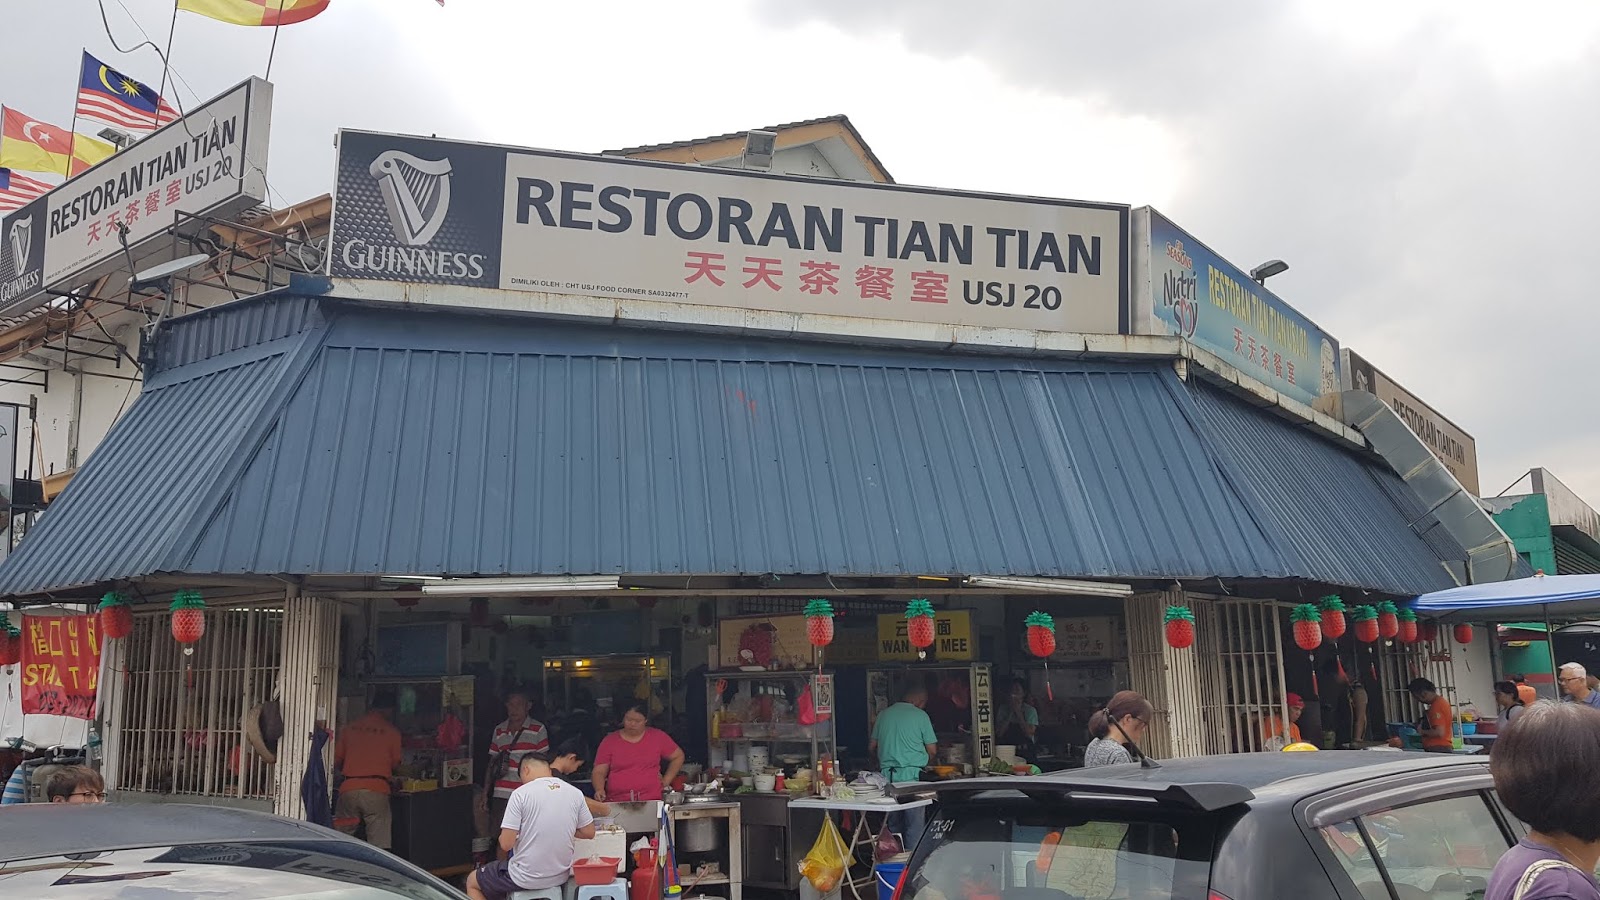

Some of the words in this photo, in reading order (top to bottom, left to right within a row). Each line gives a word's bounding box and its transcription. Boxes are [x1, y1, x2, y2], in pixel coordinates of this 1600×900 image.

[50, 162, 144, 239] RESTORAN
[147, 142, 188, 187] TIAN
[192, 116, 237, 163] TIAN
[185, 168, 211, 195] USJ
[213, 155, 233, 183] 20
[87, 178, 182, 246] 天天茶餐室
[516, 177, 843, 253] RESTORAN
[854, 215, 973, 265] TIAN
[986, 227, 1101, 276] TIAN
[342, 240, 484, 279] GUINNESS
[684, 251, 950, 304] 天天茶餐室
[0, 269, 39, 301] GUINNESS
[511, 277, 539, 286] DIMILIKI
[540, 280, 560, 288] OLEH
[596, 285, 616, 293] FOOD
[617, 287, 647, 296] CORNER
[963, 280, 1016, 308] USJ
[1023, 284, 1062, 311] 20
[1163, 269, 1197, 306] Nutri
[1208, 264, 1251, 325] RESTORAN
[1251, 293, 1269, 337] TIAN
[1234, 327, 1296, 385] 天天茶餐室
[882, 640, 909, 653] WAN
[942, 638, 967, 652] MEE
[896, 619, 951, 637] 云面
